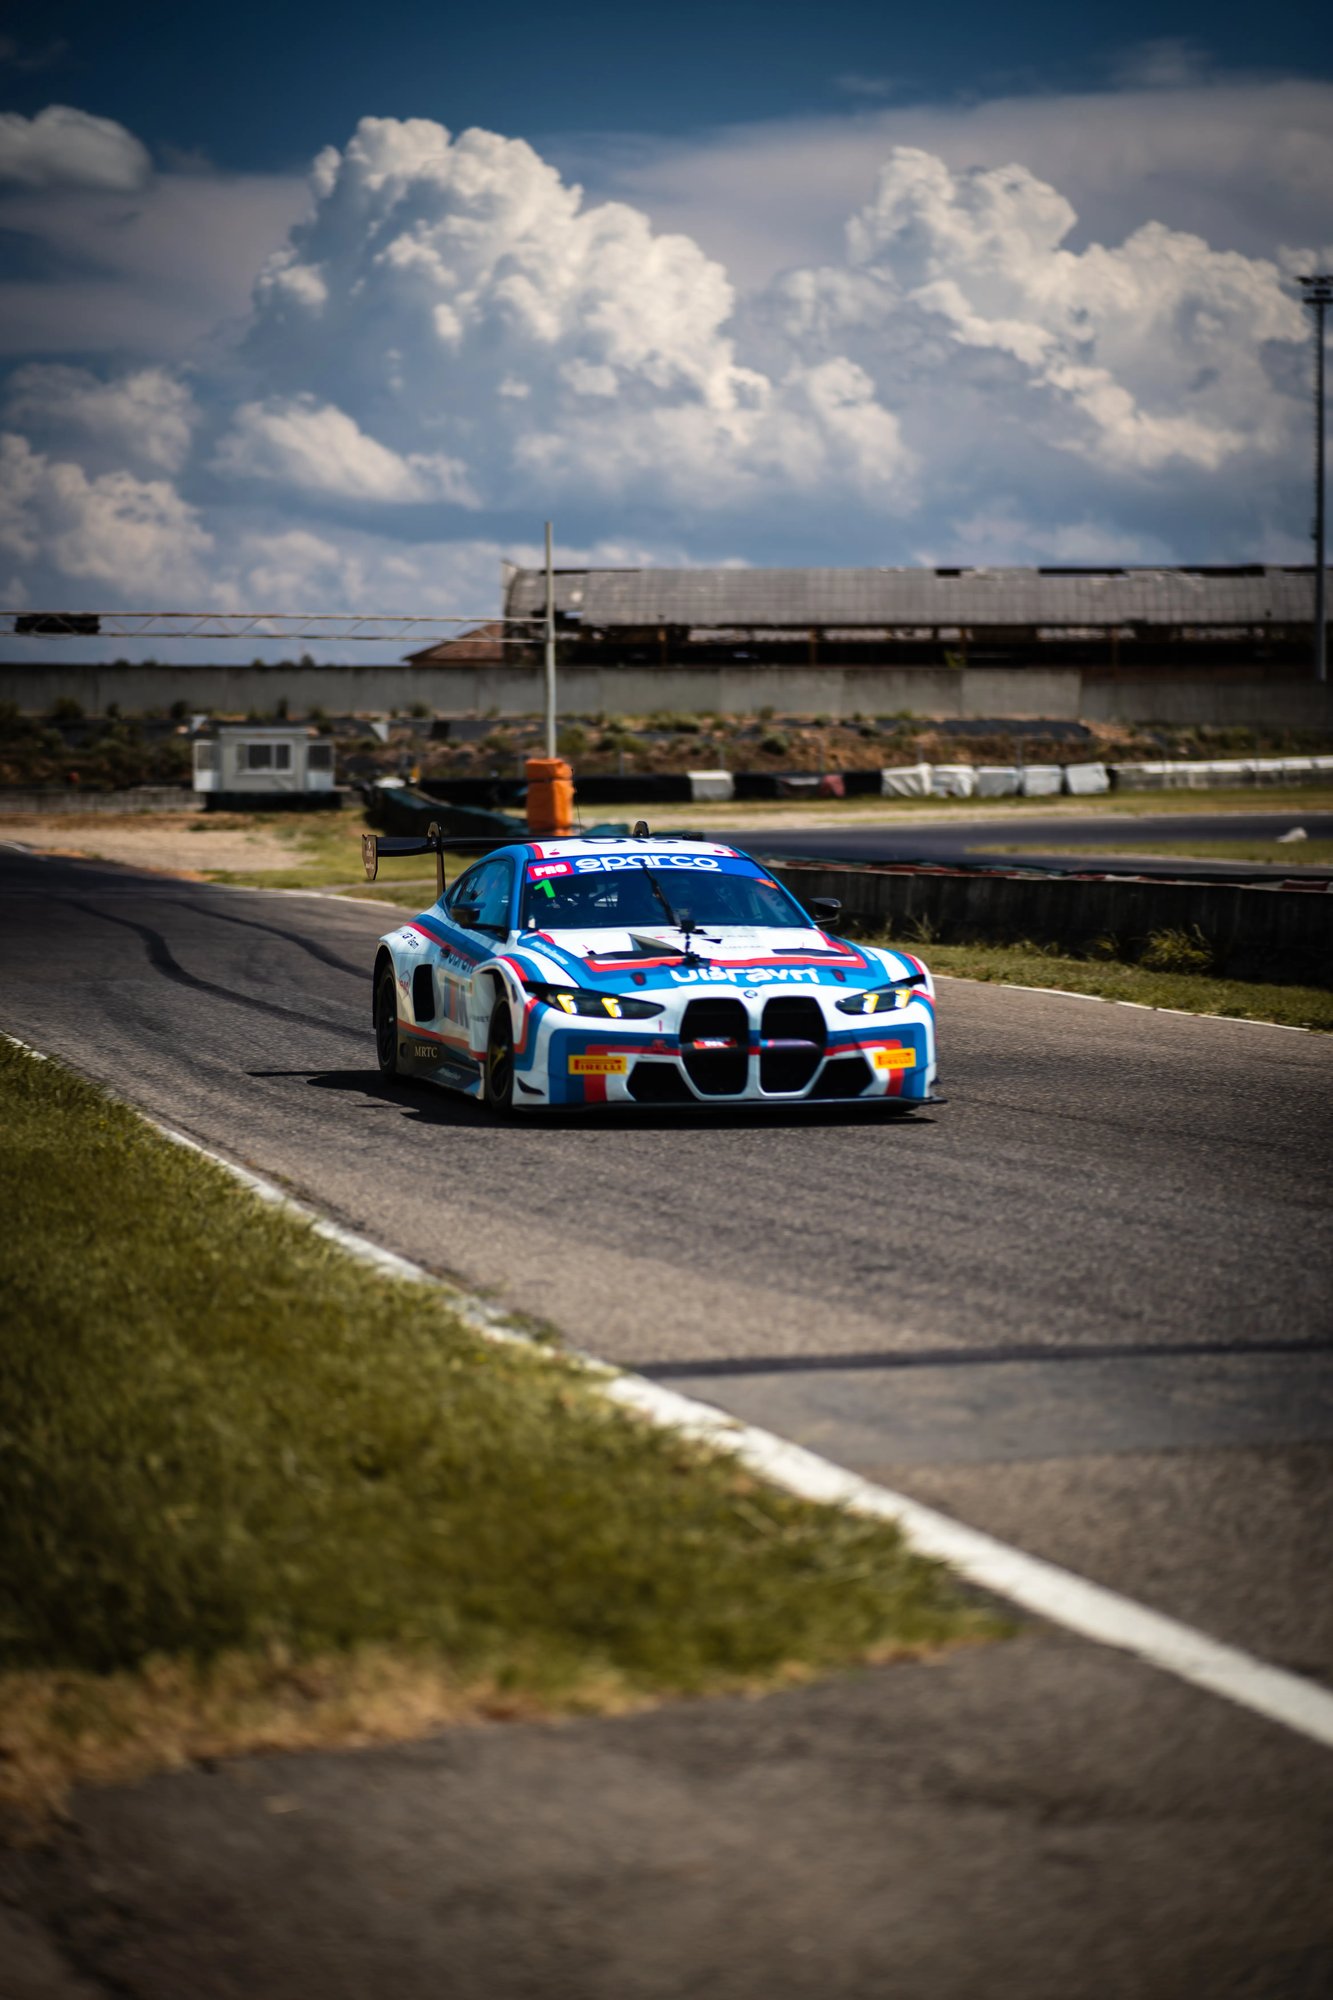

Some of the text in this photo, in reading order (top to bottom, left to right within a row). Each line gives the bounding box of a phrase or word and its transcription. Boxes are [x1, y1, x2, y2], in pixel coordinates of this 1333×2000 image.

[534, 863, 568, 877] PRO
[575, 855, 720, 872] sparco
[534, 879, 556, 898] 1
[414, 1046, 438, 1058] MRTC
[573, 1058, 623, 1071] PIRELLI
